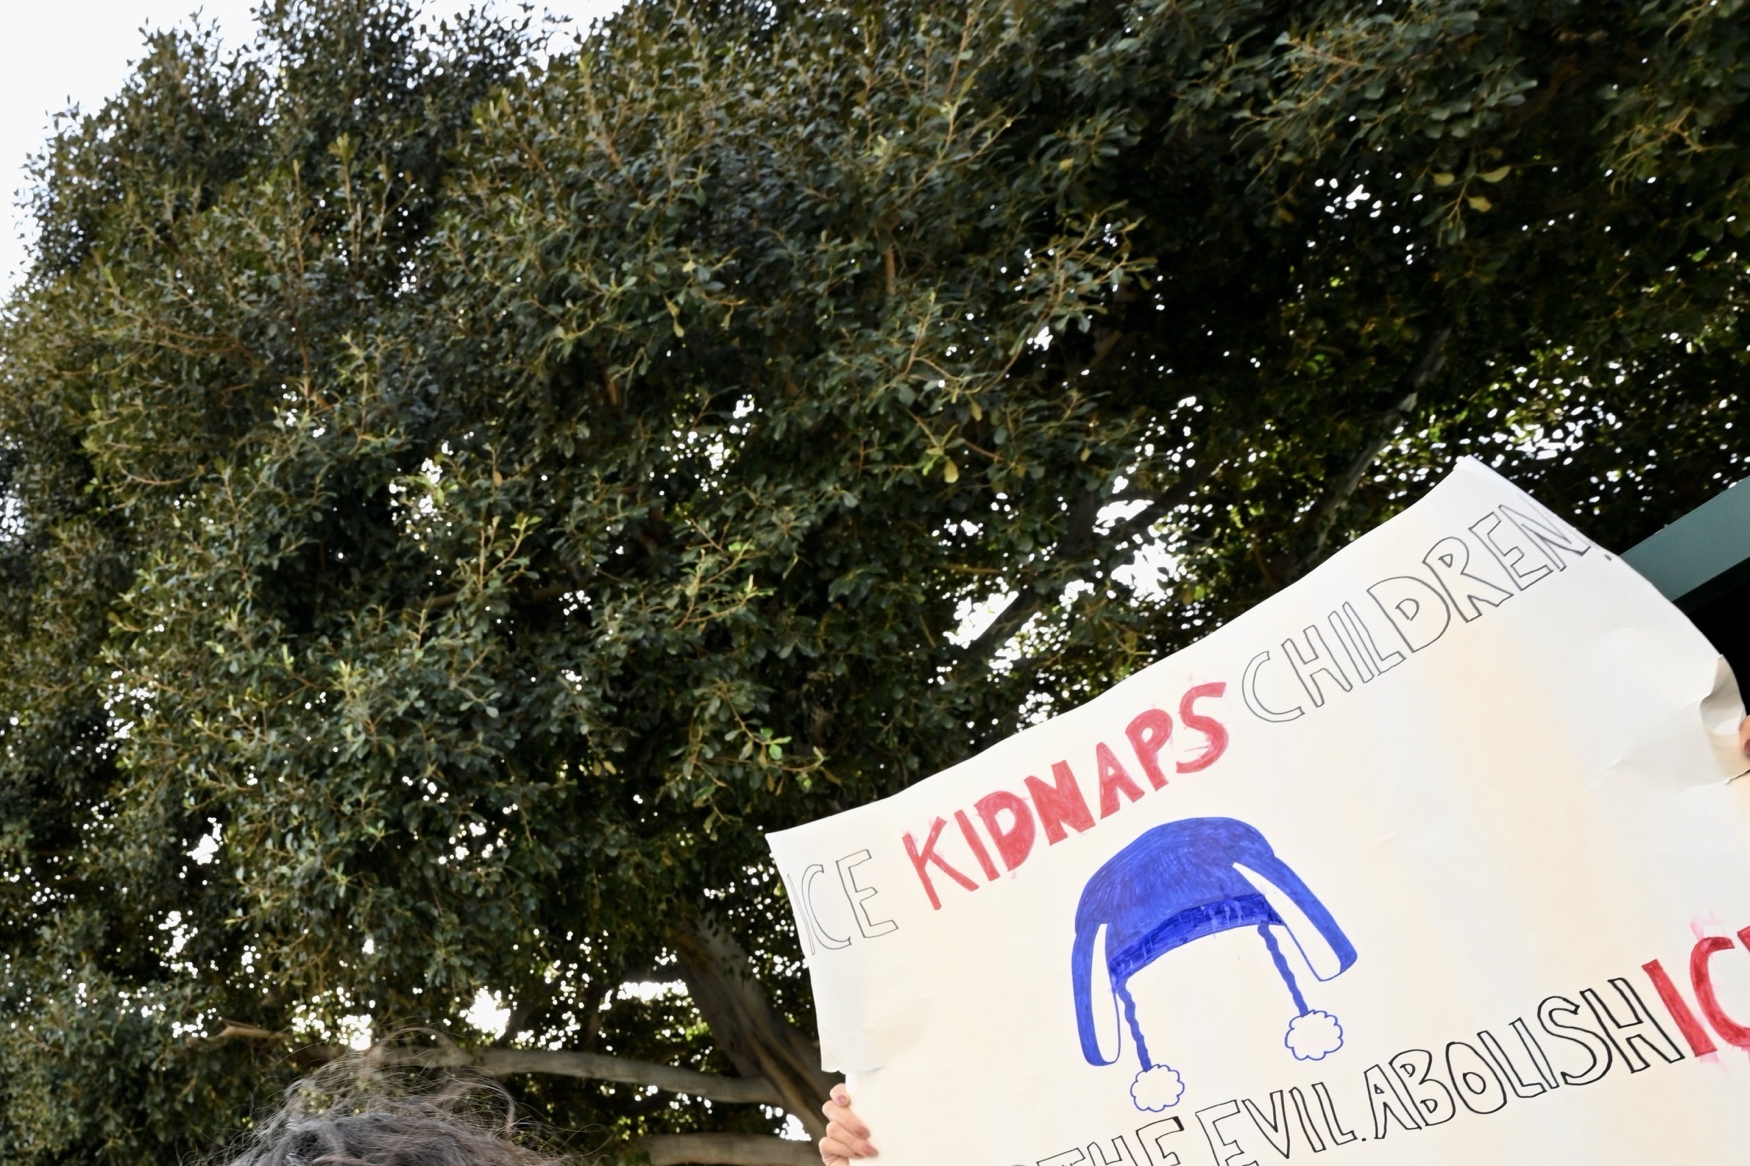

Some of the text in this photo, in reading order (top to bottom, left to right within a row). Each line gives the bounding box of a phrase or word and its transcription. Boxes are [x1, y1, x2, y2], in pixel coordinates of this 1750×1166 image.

[787, 848, 899, 955] ICE
[901, 680, 1229, 910] KIDNAPS
[1366, 977, 1685, 1140] ABOLISH
[1641, 926, 1750, 1057] IC
